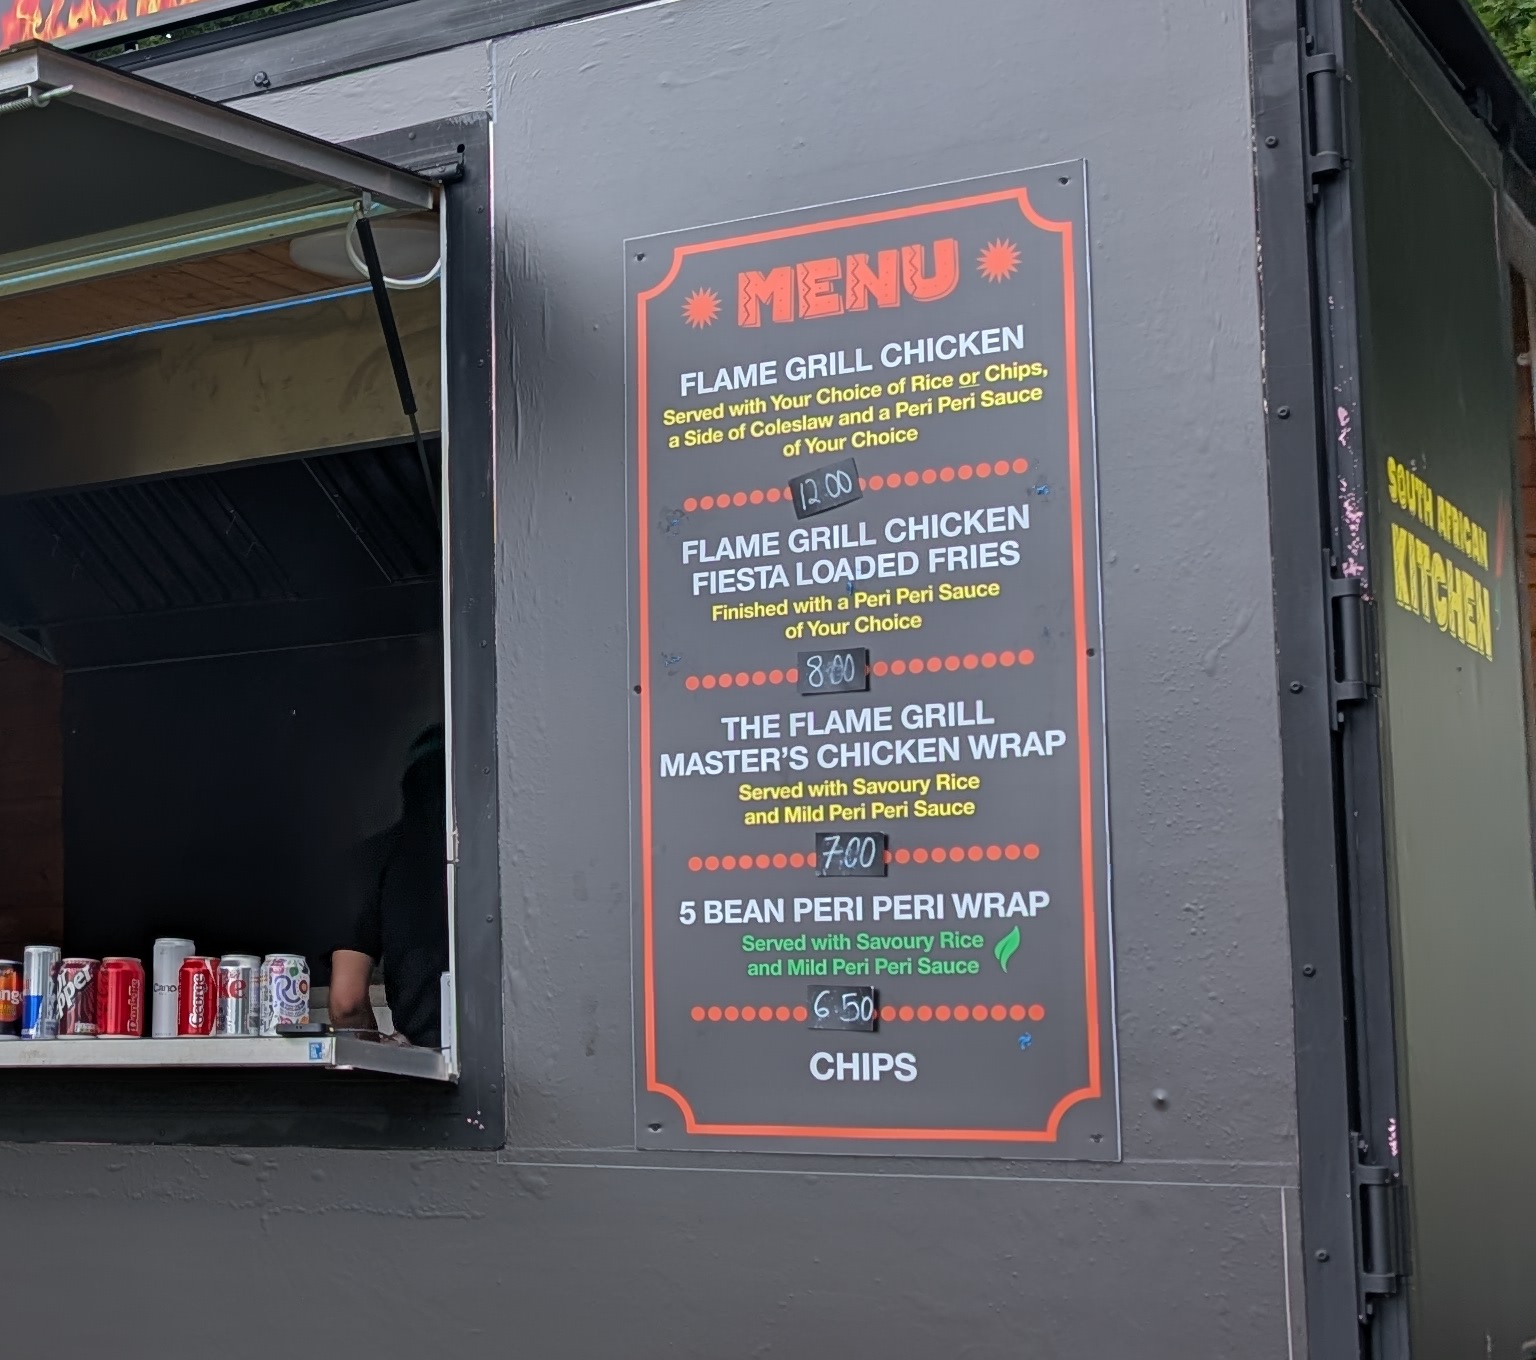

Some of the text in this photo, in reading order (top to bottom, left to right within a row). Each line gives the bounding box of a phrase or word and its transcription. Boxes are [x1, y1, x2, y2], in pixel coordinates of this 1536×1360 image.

[737, 237, 960, 328] MENU
[680, 324, 1024, 397] FLAME GRILL CHICKEN
[663, 361, 1048, 426] Served with Your Choice of Rice or Chips,
[668, 387, 1043, 449] a Side of Coleslaw and a Peri Peri Sauce
[783, 427, 919, 457] of Your Choice
[682, 503, 1030, 564] FLAME GRILL CHICKEN
[1387, 456, 1489, 572] SOUTH AFRICAN
[692, 540, 1020, 596] FIESTA LOADED FRIES
[712, 582, 1000, 622] Finished with a Peri Peri Sauce
[1391, 522, 1493, 663] KITCHEN
[785, 613, 923, 639] of Your Choice
[720, 699, 995, 741] THE FLAME GRILL
[660, 729, 1067, 777] MASTER'S CHICKEN WRAP
[738, 773, 980, 801] Served with Savoury Rice
[744, 799, 975, 825] and Mild Peri Peri Sauce
[679, 890, 1050, 925] 5 BEAN PERI PERI WRAP
[742, 931, 984, 953] Served with Savoury Rice
[747, 956, 980, 976] and Mild Peri Peri Sauce
[189, 973, 209, 1029] George
[809, 1051, 918, 1082] CHIPS
